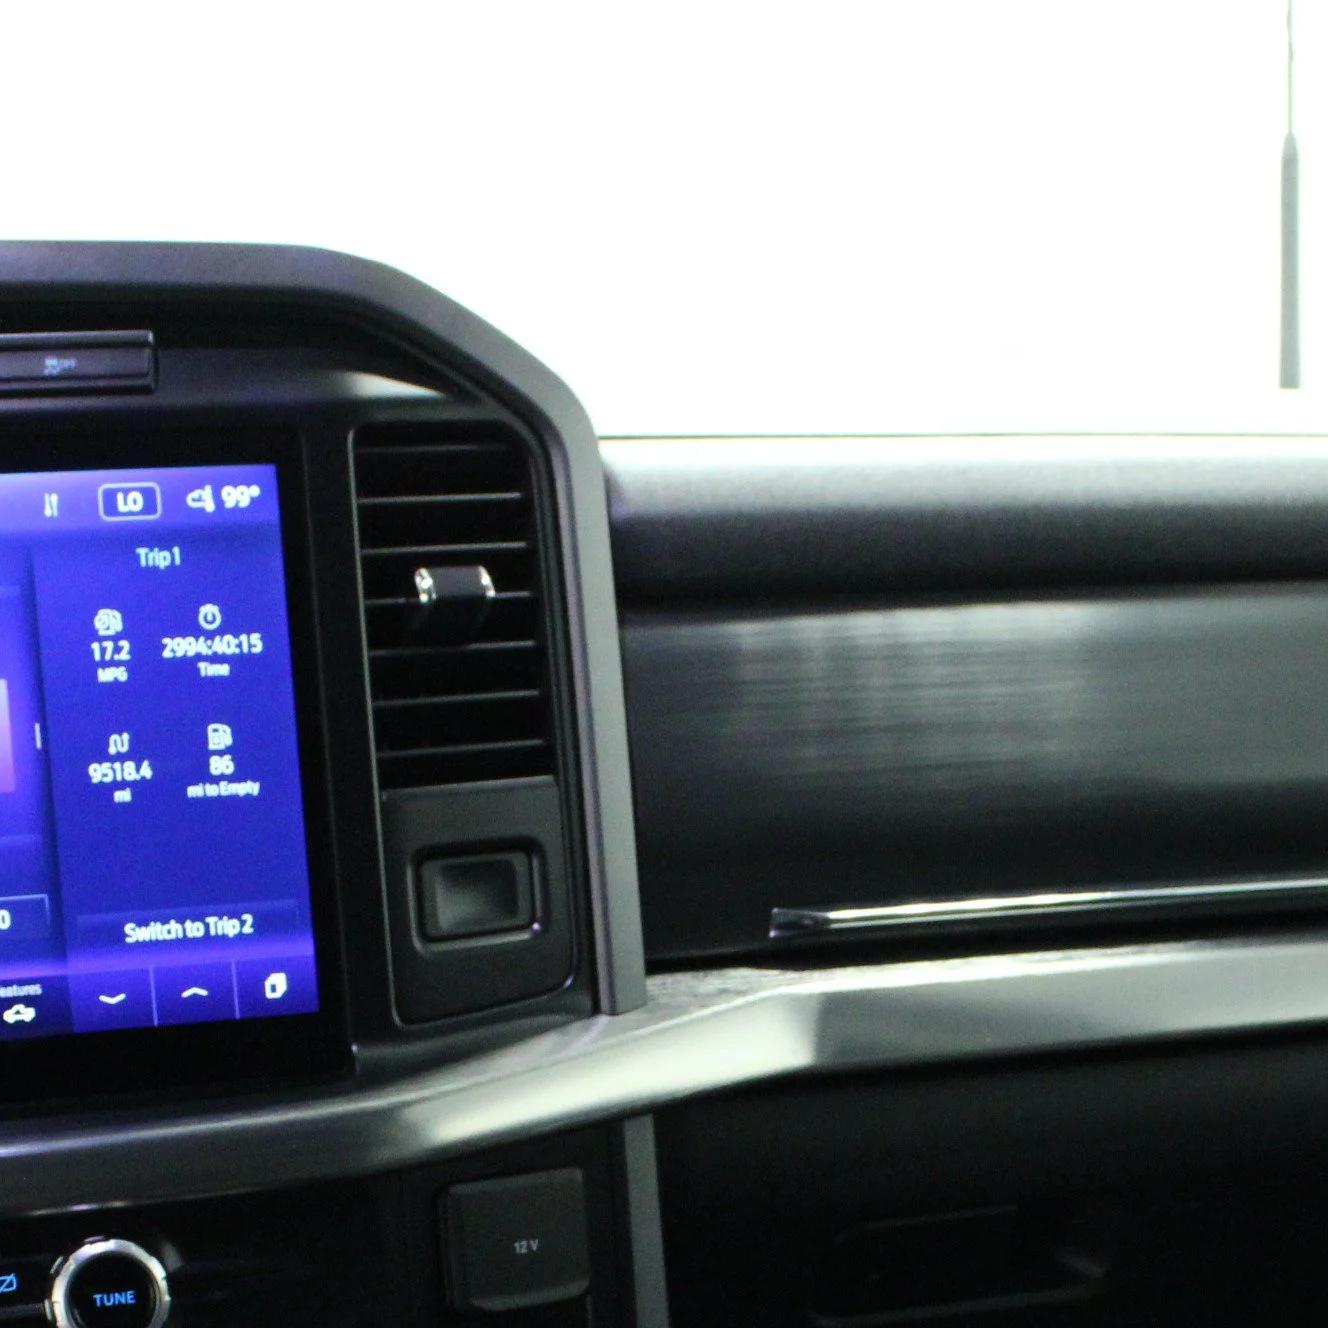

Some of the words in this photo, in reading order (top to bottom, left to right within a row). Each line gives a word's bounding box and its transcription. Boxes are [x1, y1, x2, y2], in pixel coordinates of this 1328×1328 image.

[116, 490, 144, 513] LO
[221, 484, 261, 509] 99°
[90, 640, 131, 663] 17.2
[161, 633, 263, 659] 2994:40:15
[97, 665, 128, 684] MPG
[197, 660, 231, 679] Time
[88, 760, 154, 785] 9518.4
[209, 755, 234, 777] 86
[114, 787, 132, 804] mi
[187, 782, 204, 799] mi
[219, 778, 260, 799] Empty
[124, 920, 182, 943] Switch
[184, 922, 204, 939] to
[207, 915, 240, 938] Trip
[241, 914, 254, 935] 2
[92, 1289, 136, 1308] TUNE
